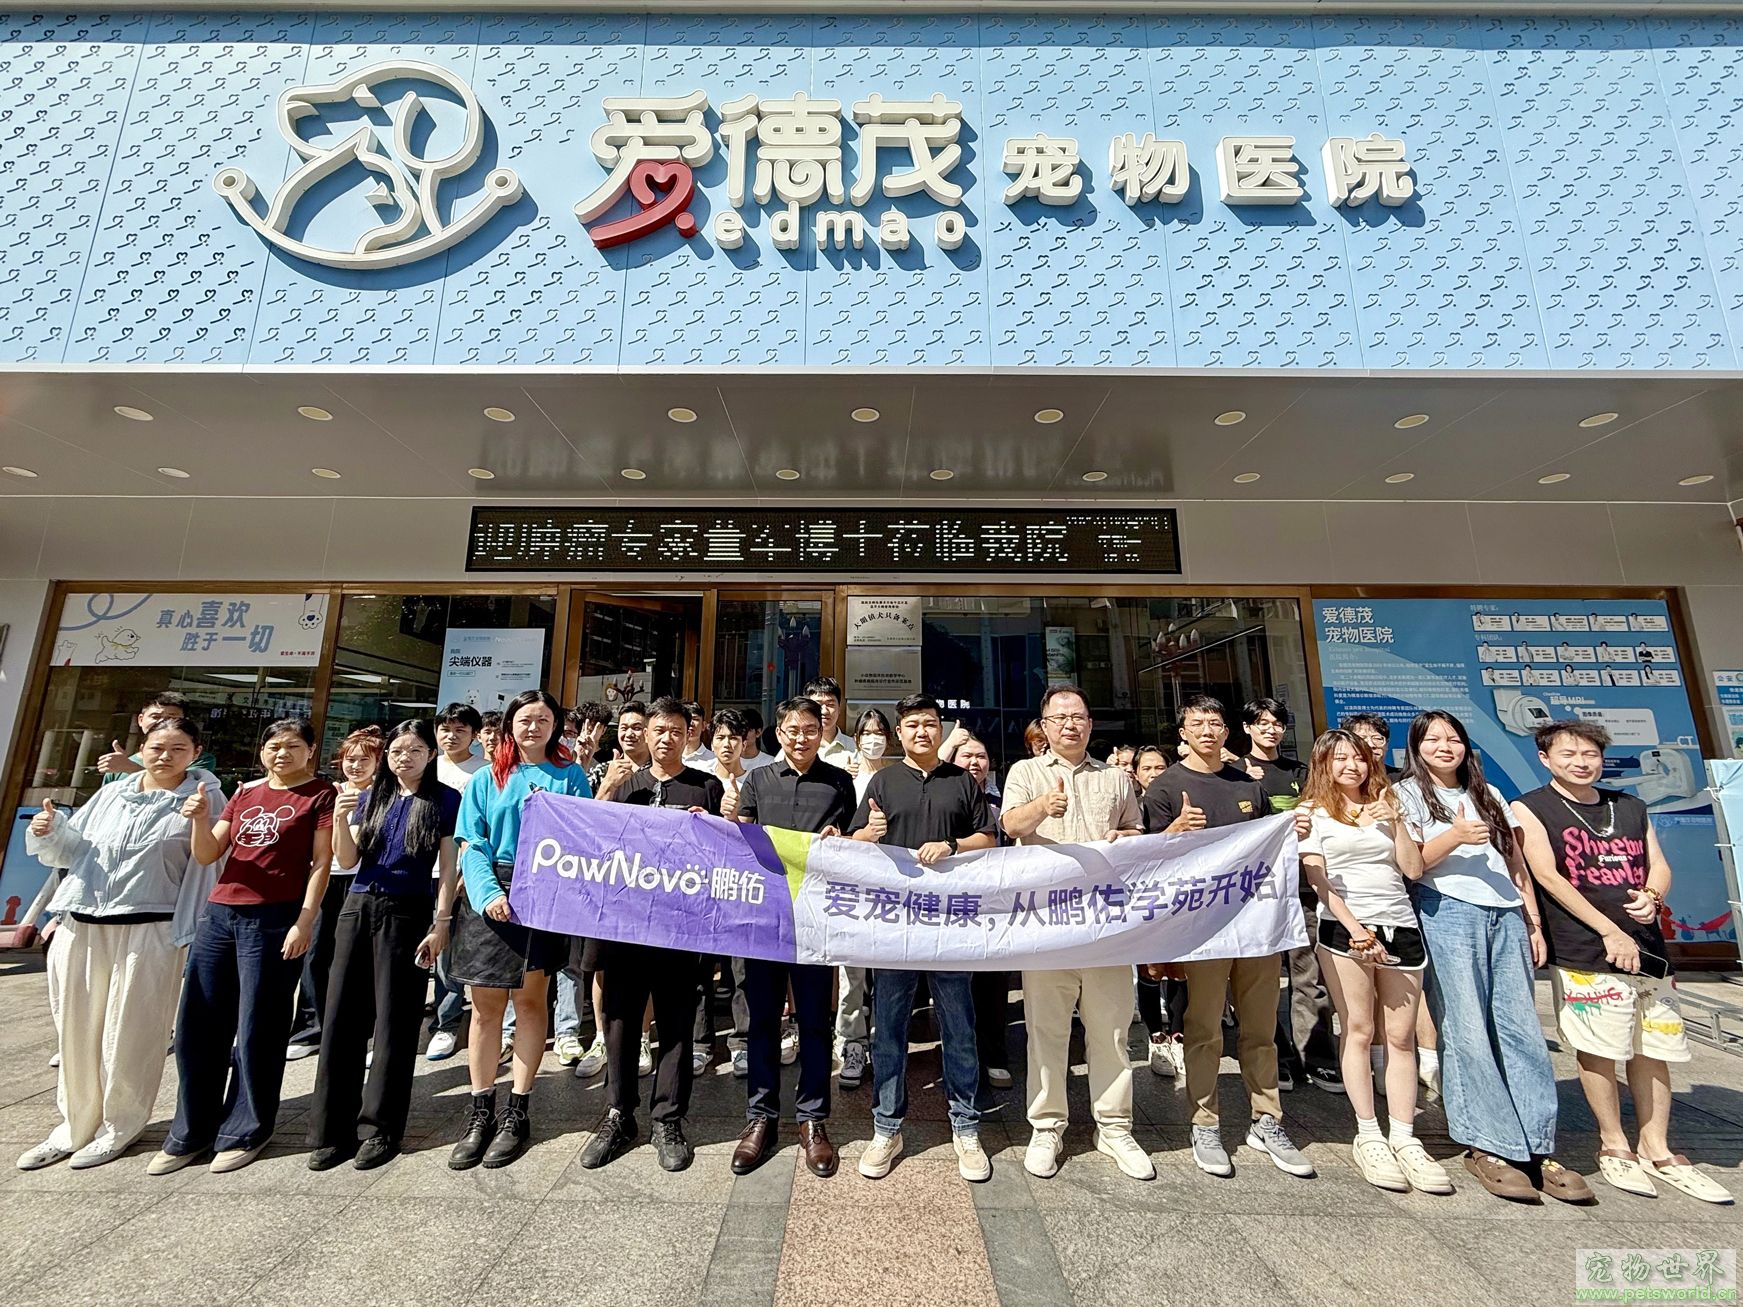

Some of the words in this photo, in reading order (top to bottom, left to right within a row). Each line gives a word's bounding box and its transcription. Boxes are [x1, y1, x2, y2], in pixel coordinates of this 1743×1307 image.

[573, 90, 963, 249] 爱德茂
[1003, 132, 1414, 207] 宠物医院
[712, 201, 965, 251] edmao
[156, 600, 251, 629] 真心喜欢
[1322, 606, 1374, 624] 爱德茂
[179, 624, 275, 653] 胜于一切
[1325, 626, 1395, 643] 宠物医院
[448, 655, 493, 667] 尖端仪器
[1677, 735, 1694, 747] CT
[531, 838, 702, 895] PawNovo
[711, 867, 765, 905] 鹏佑
